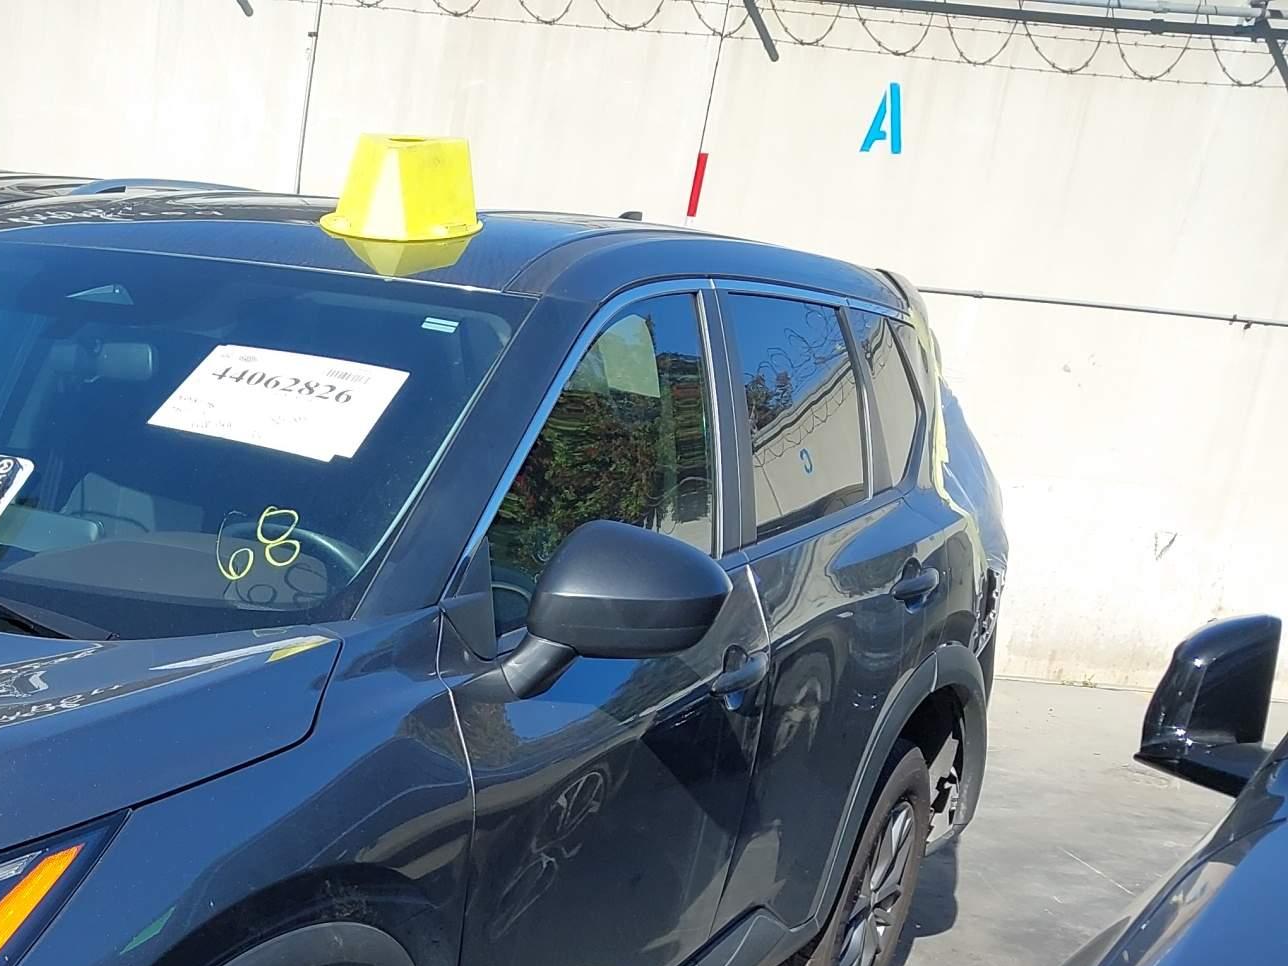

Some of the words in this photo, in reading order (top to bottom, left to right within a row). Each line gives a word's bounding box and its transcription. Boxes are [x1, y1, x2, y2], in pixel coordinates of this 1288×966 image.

[859, 82, 902, 154] A
[212, 366, 352, 404] 44062826
[216, 506, 301, 580] 68
